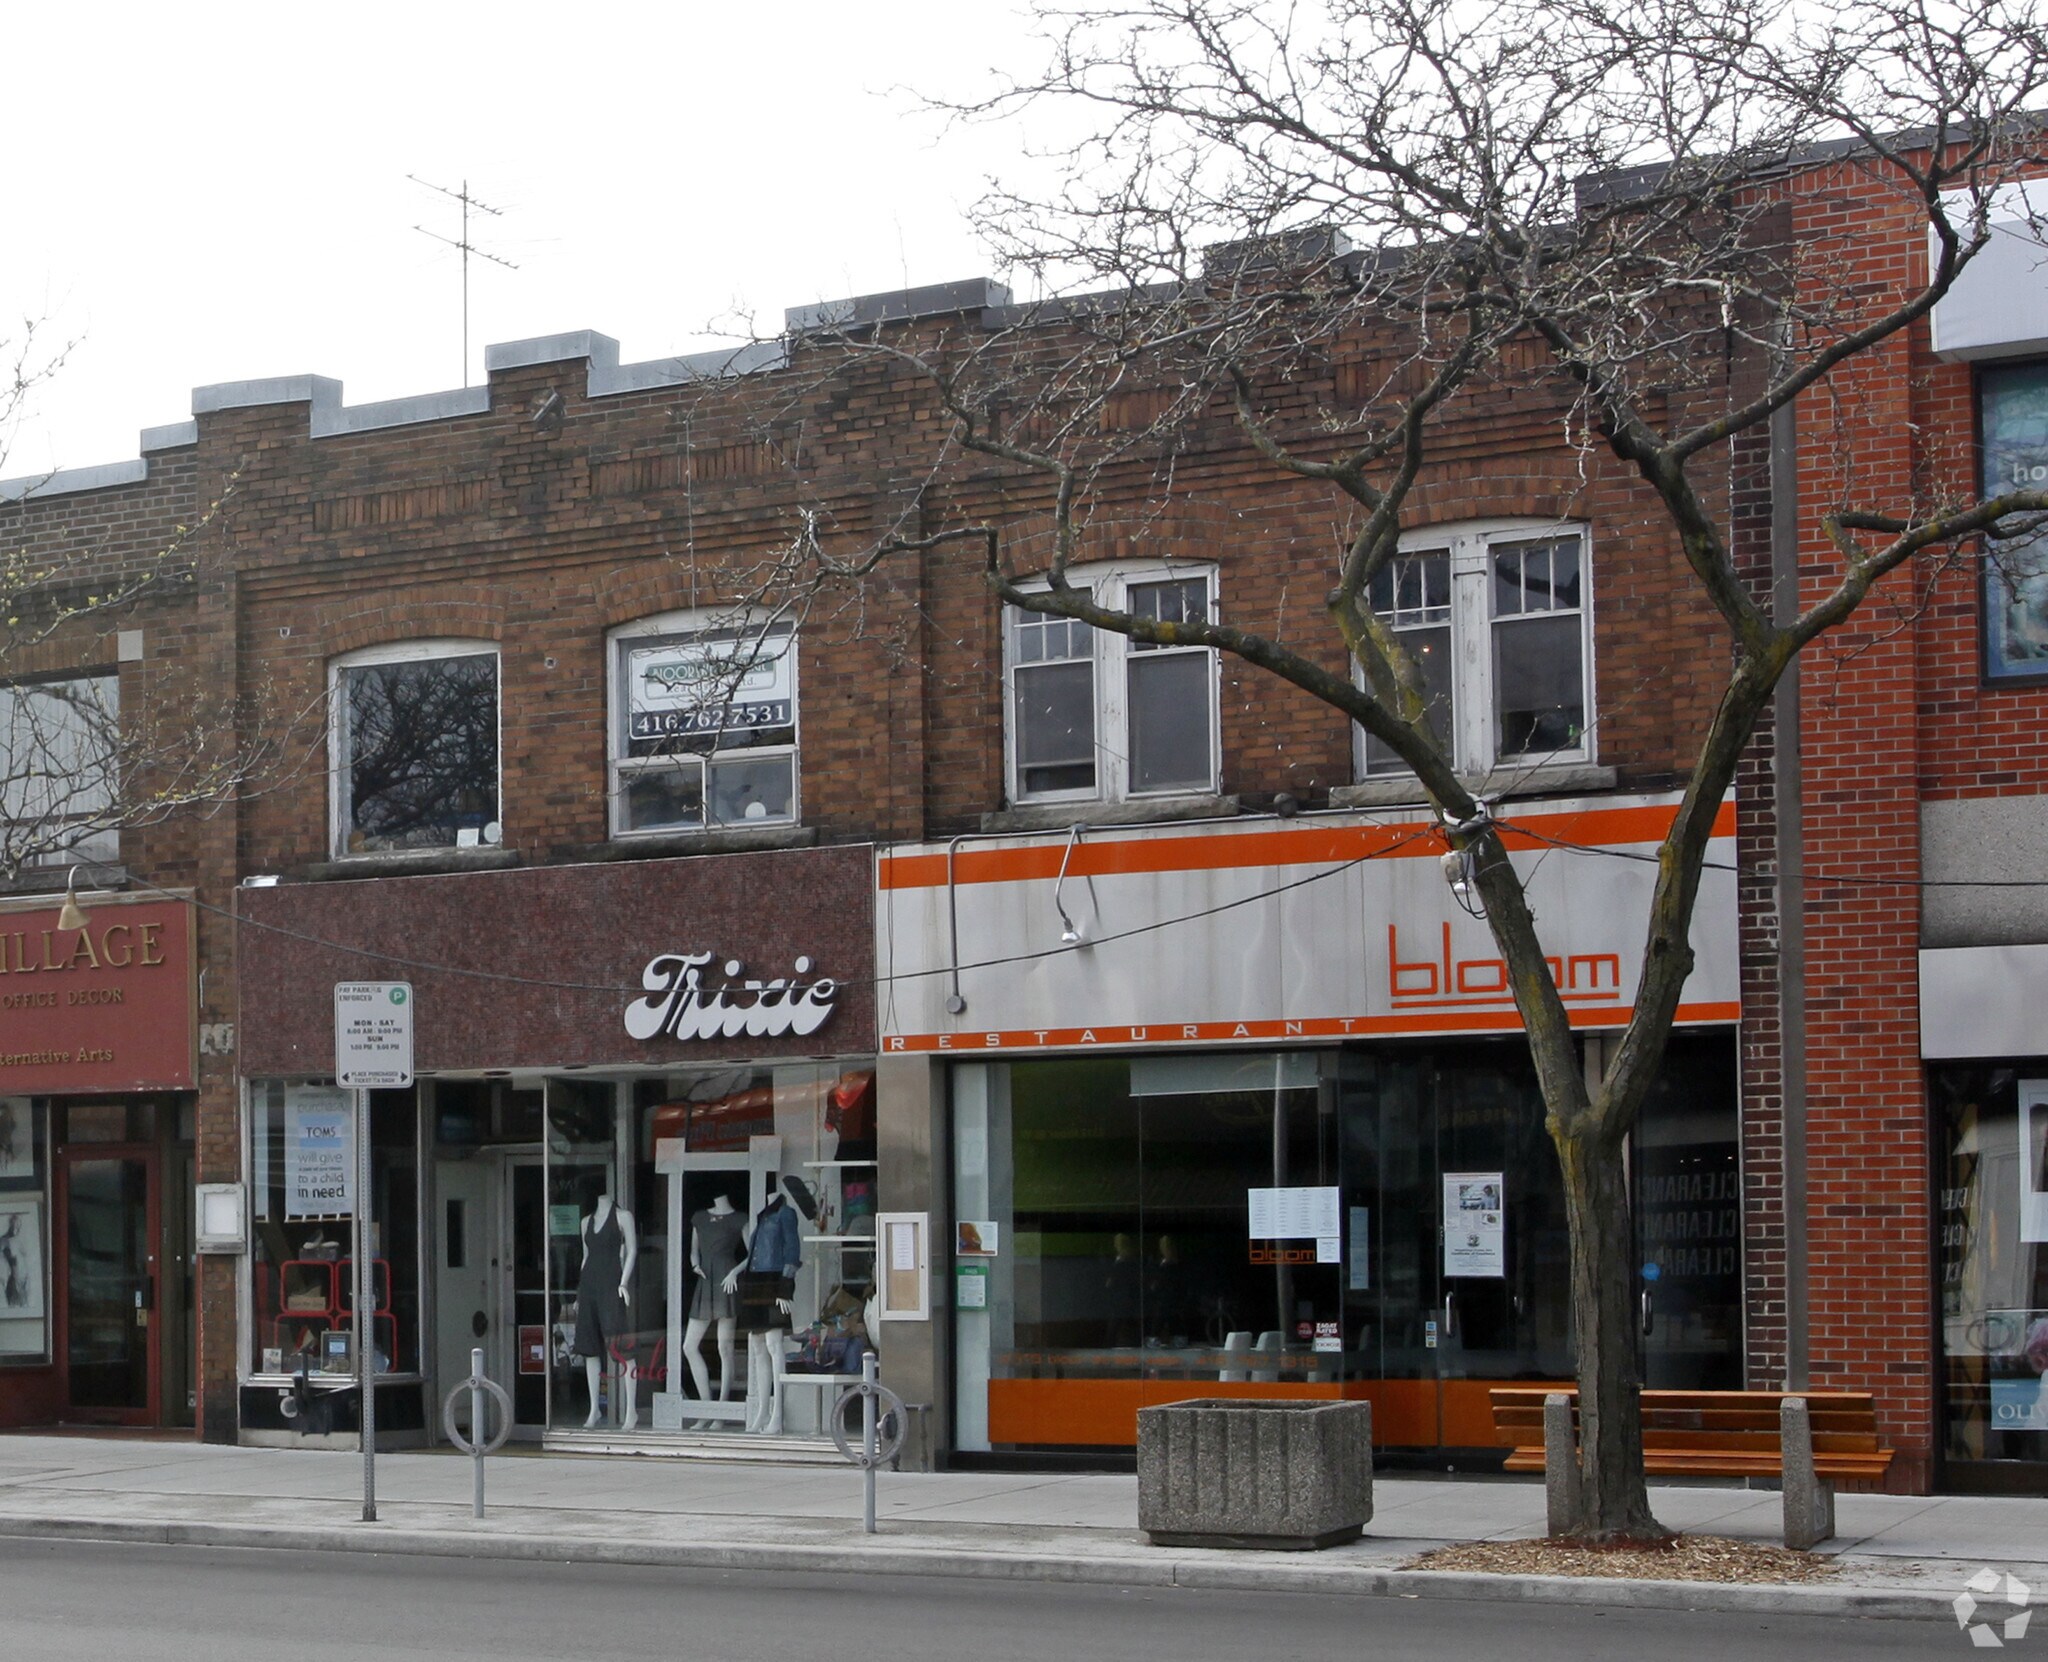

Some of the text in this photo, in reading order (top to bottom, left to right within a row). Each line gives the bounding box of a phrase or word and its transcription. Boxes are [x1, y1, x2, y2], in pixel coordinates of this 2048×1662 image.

[637, 704, 786, 734] 416.762.7531
[2, 988, 124, 1009] OFFICE DECOR
[624, 950, 838, 1041] Trixie
[890, 1019, 1356, 1051] RESTAURANT
[76, 1047, 114, 1063] Arts
[305, 1126, 336, 1138] TOMS
[298, 1151, 343, 1166] will give
[298, 1174, 309, 1184] to
[320, 1172, 344, 1184] child
[297, 1184, 309, 1198] in
